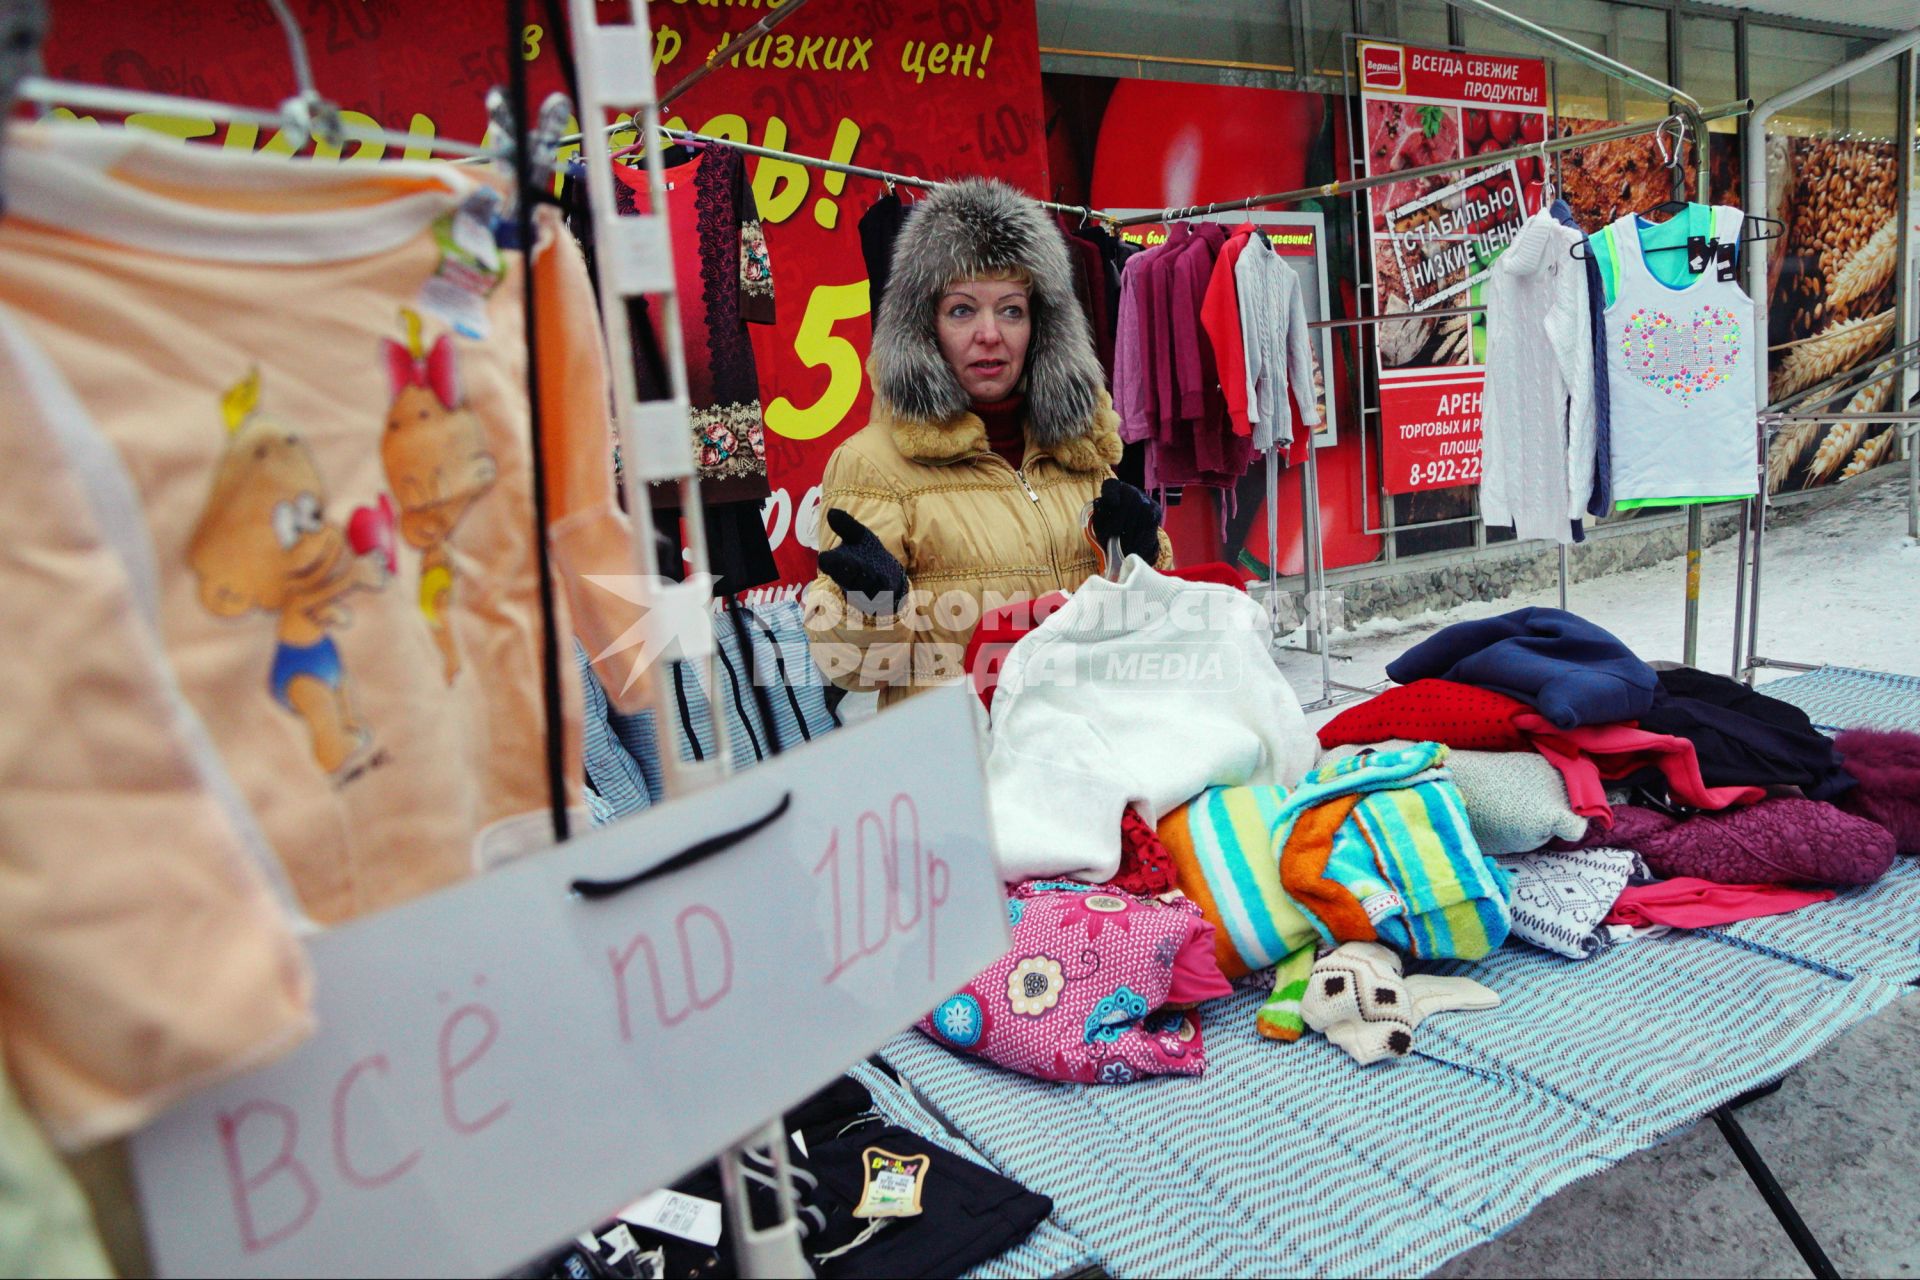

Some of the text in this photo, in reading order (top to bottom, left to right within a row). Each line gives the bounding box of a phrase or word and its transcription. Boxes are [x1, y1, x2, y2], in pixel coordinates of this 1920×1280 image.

[901, 34, 993, 83] цен!
[1367, 59, 1399, 72] Верный
[1412, 54, 1519, 80] ВСЕГДА СВЕЖИЕ
[1464, 81, 1538, 103] ПРОДУКТЫ!
[1403, 186, 1514, 251] СТАБИЛЬНО
[1412, 239, 1476, 289] НИЗКИЕ
[764, 278, 871, 440] 5
[1399, 419, 1460, 440] ТОРГОВЫХ
[1462, 418, 1471, 433] И
